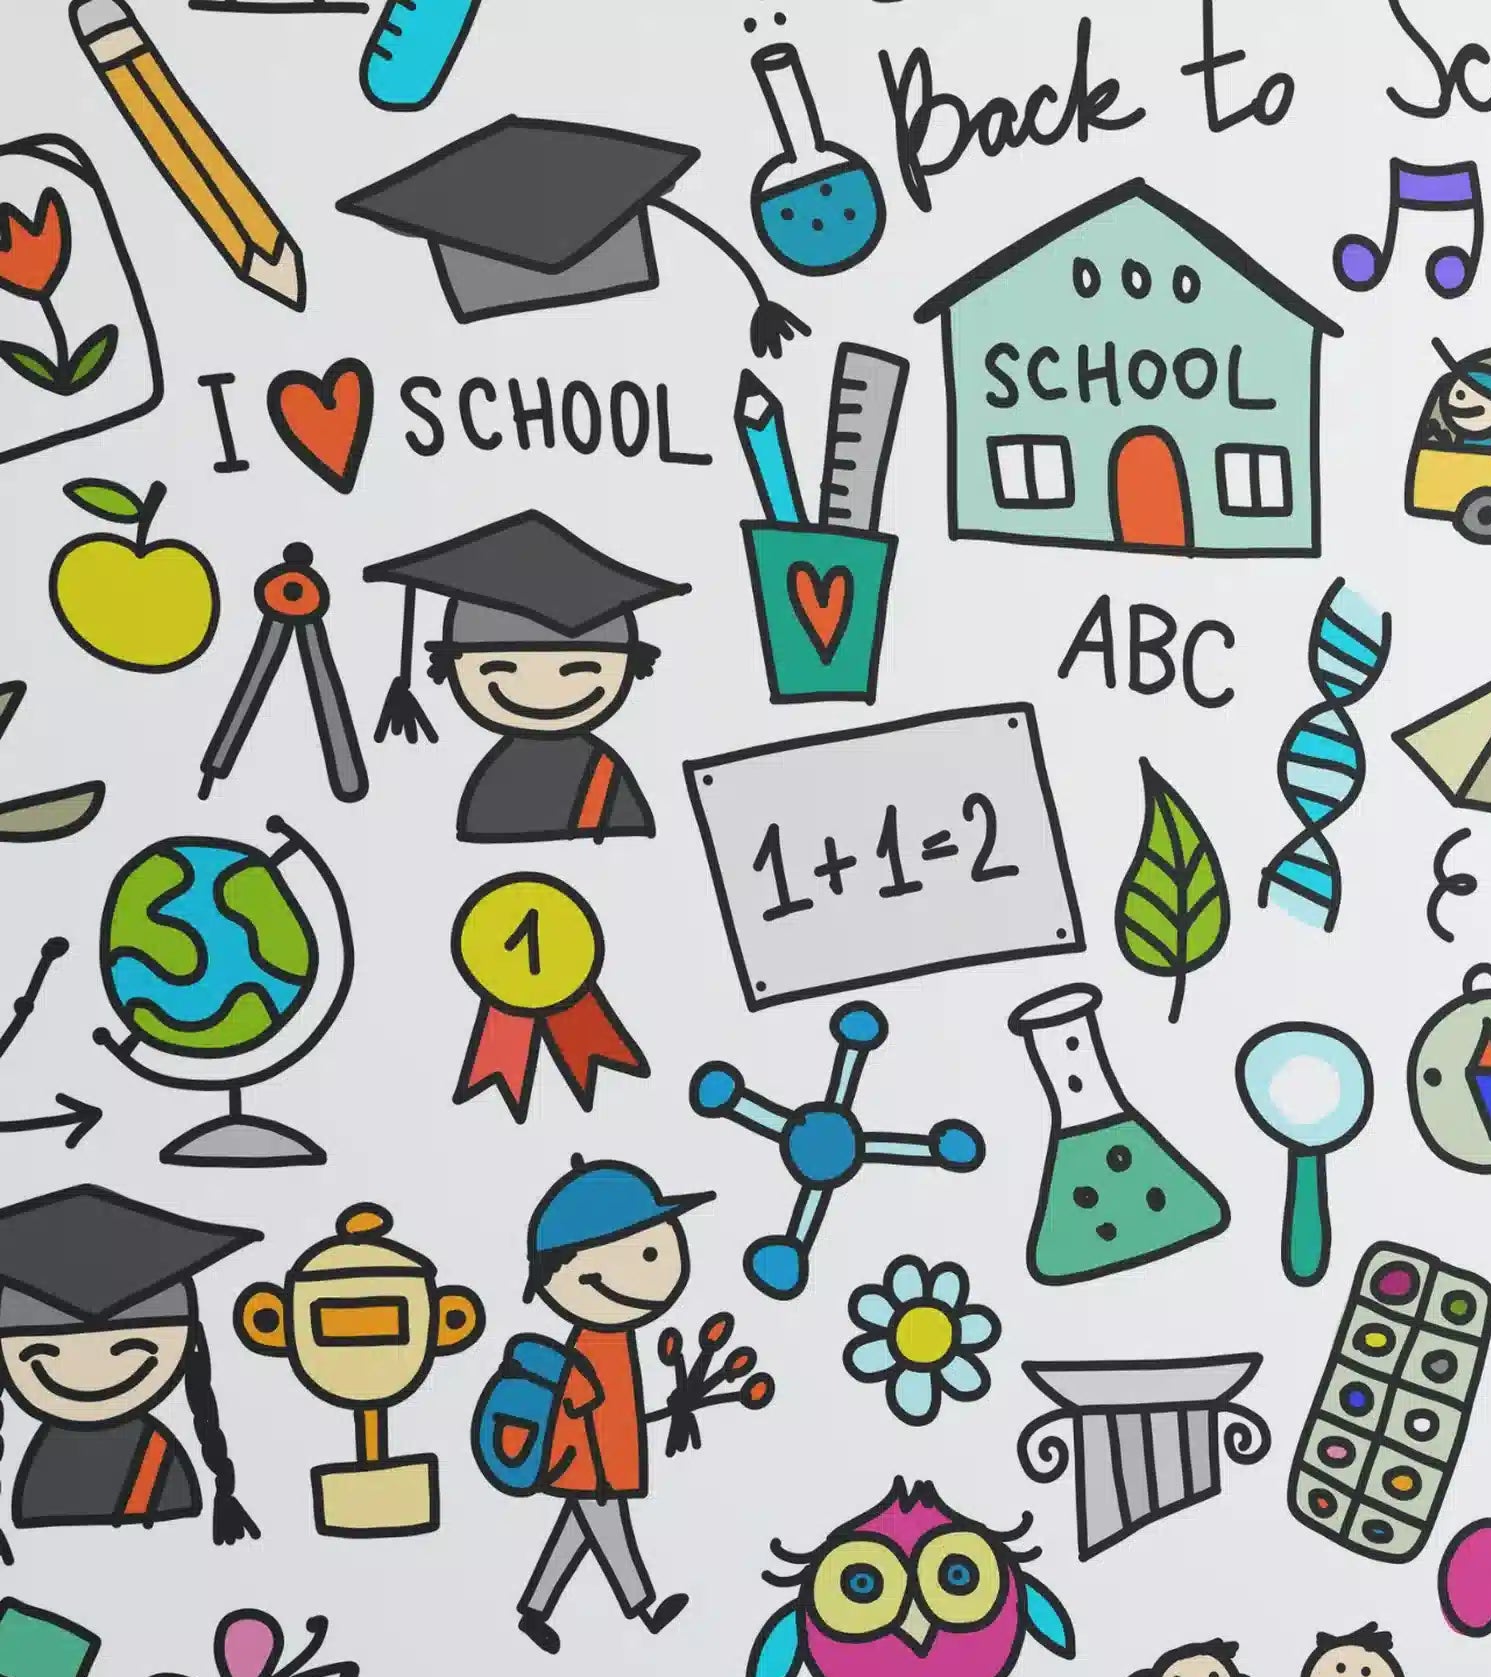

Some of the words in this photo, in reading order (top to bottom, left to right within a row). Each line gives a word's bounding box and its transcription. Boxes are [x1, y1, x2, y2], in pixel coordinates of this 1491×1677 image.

[879, 16, 1147, 213] Back
[1180, 0, 1295, 133] to
[197, 372, 250, 474] I
[400, 375, 713, 466] SCHOOL
[984, 340, 1277, 411] SCHOOL
[1057, 594, 1235, 709] ABC
[503, 908, 541, 976] 1
